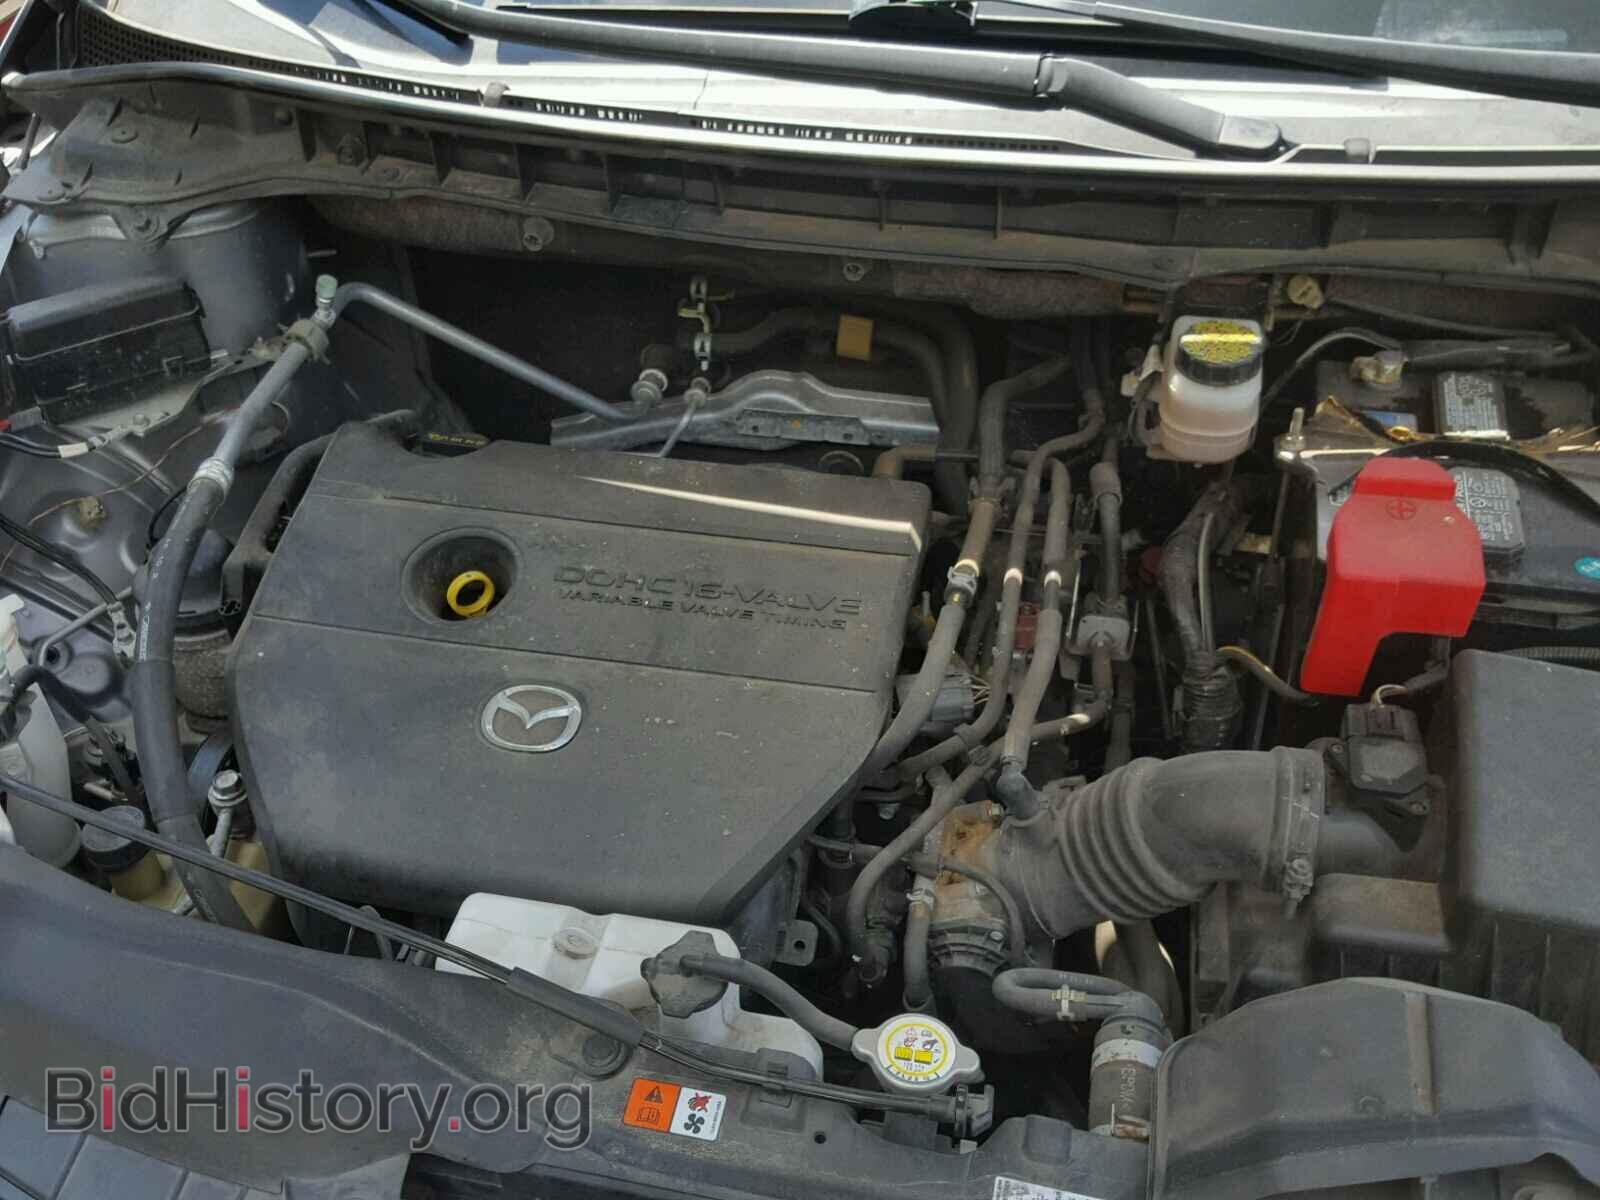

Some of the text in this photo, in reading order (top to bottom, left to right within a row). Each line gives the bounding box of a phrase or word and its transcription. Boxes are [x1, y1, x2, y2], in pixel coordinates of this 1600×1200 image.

[553, 566, 862, 615] DOHC 16-VALVE
[560, 589, 847, 630] VARIABLE VALVE TIMING
